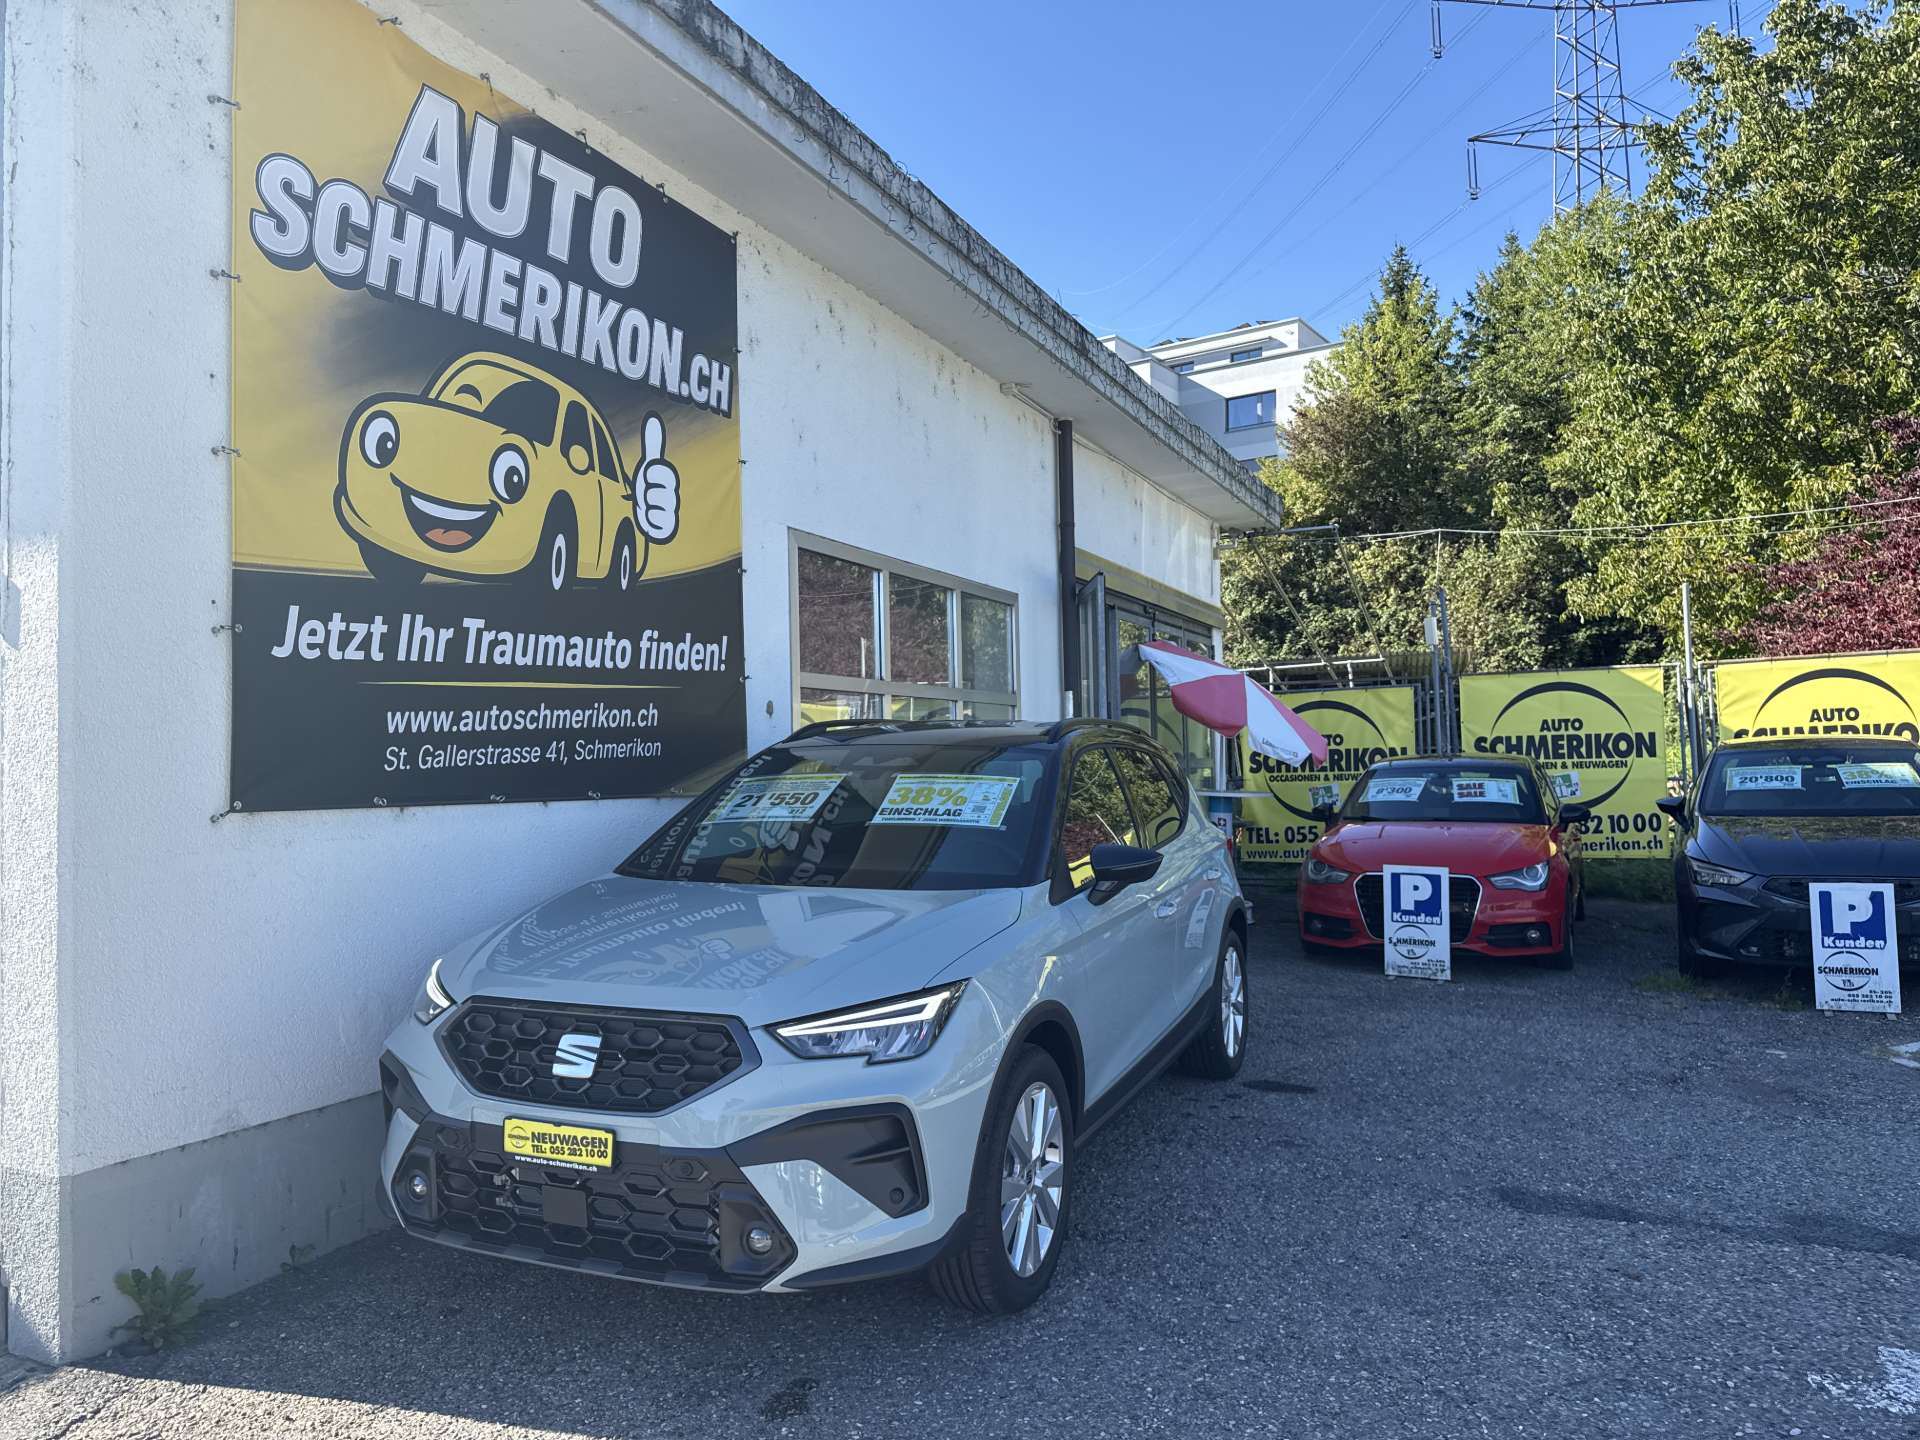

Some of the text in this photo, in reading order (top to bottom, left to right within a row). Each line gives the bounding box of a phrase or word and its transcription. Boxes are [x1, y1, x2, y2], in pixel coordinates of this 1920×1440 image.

[385, 85, 643, 289] AUTO
[251, 154, 732, 415] SCHMERIKON.CH
[271, 604, 728, 672] Jetzt Ihr Traumauto finden!
[386, 702, 659, 734] www.autoschmerikon.ch
[1809, 707, 1860, 723] AUTO
[1539, 718, 1584, 732] AUTO
[1474, 732, 1657, 759] SCHMERIKON
[383, 738, 662, 772] St. Gallerstrasse 41, Schmerikon
[1560, 761, 1568, 769] &
[1571, 759, 1628, 769] NEUWAGEN
[1268, 774, 1321, 783] OCCASIONEN
[1323, 774, 1330, 782] &
[733, 790, 821, 808] 21'550
[886, 785, 969, 807] 38%
[878, 806, 964, 818] EINSCHLAG
[1579, 812, 1662, 835] 82 10 00
[1245, 825, 1319, 845] TEL: 055
[1392, 911, 1441, 925] Kunden
[1388, 936, 1436, 948] SHMERIKON
[1822, 936, 1885, 950] Kunden
[1817, 965, 1879, 976] SCHMERIKON
[531, 1132, 608, 1149] NEUWAGEN
[531, 1144, 609, 1159] TEL: 055 282 10 00
[514, 1156, 597, 1172] www.auto-schmerikon.ch
